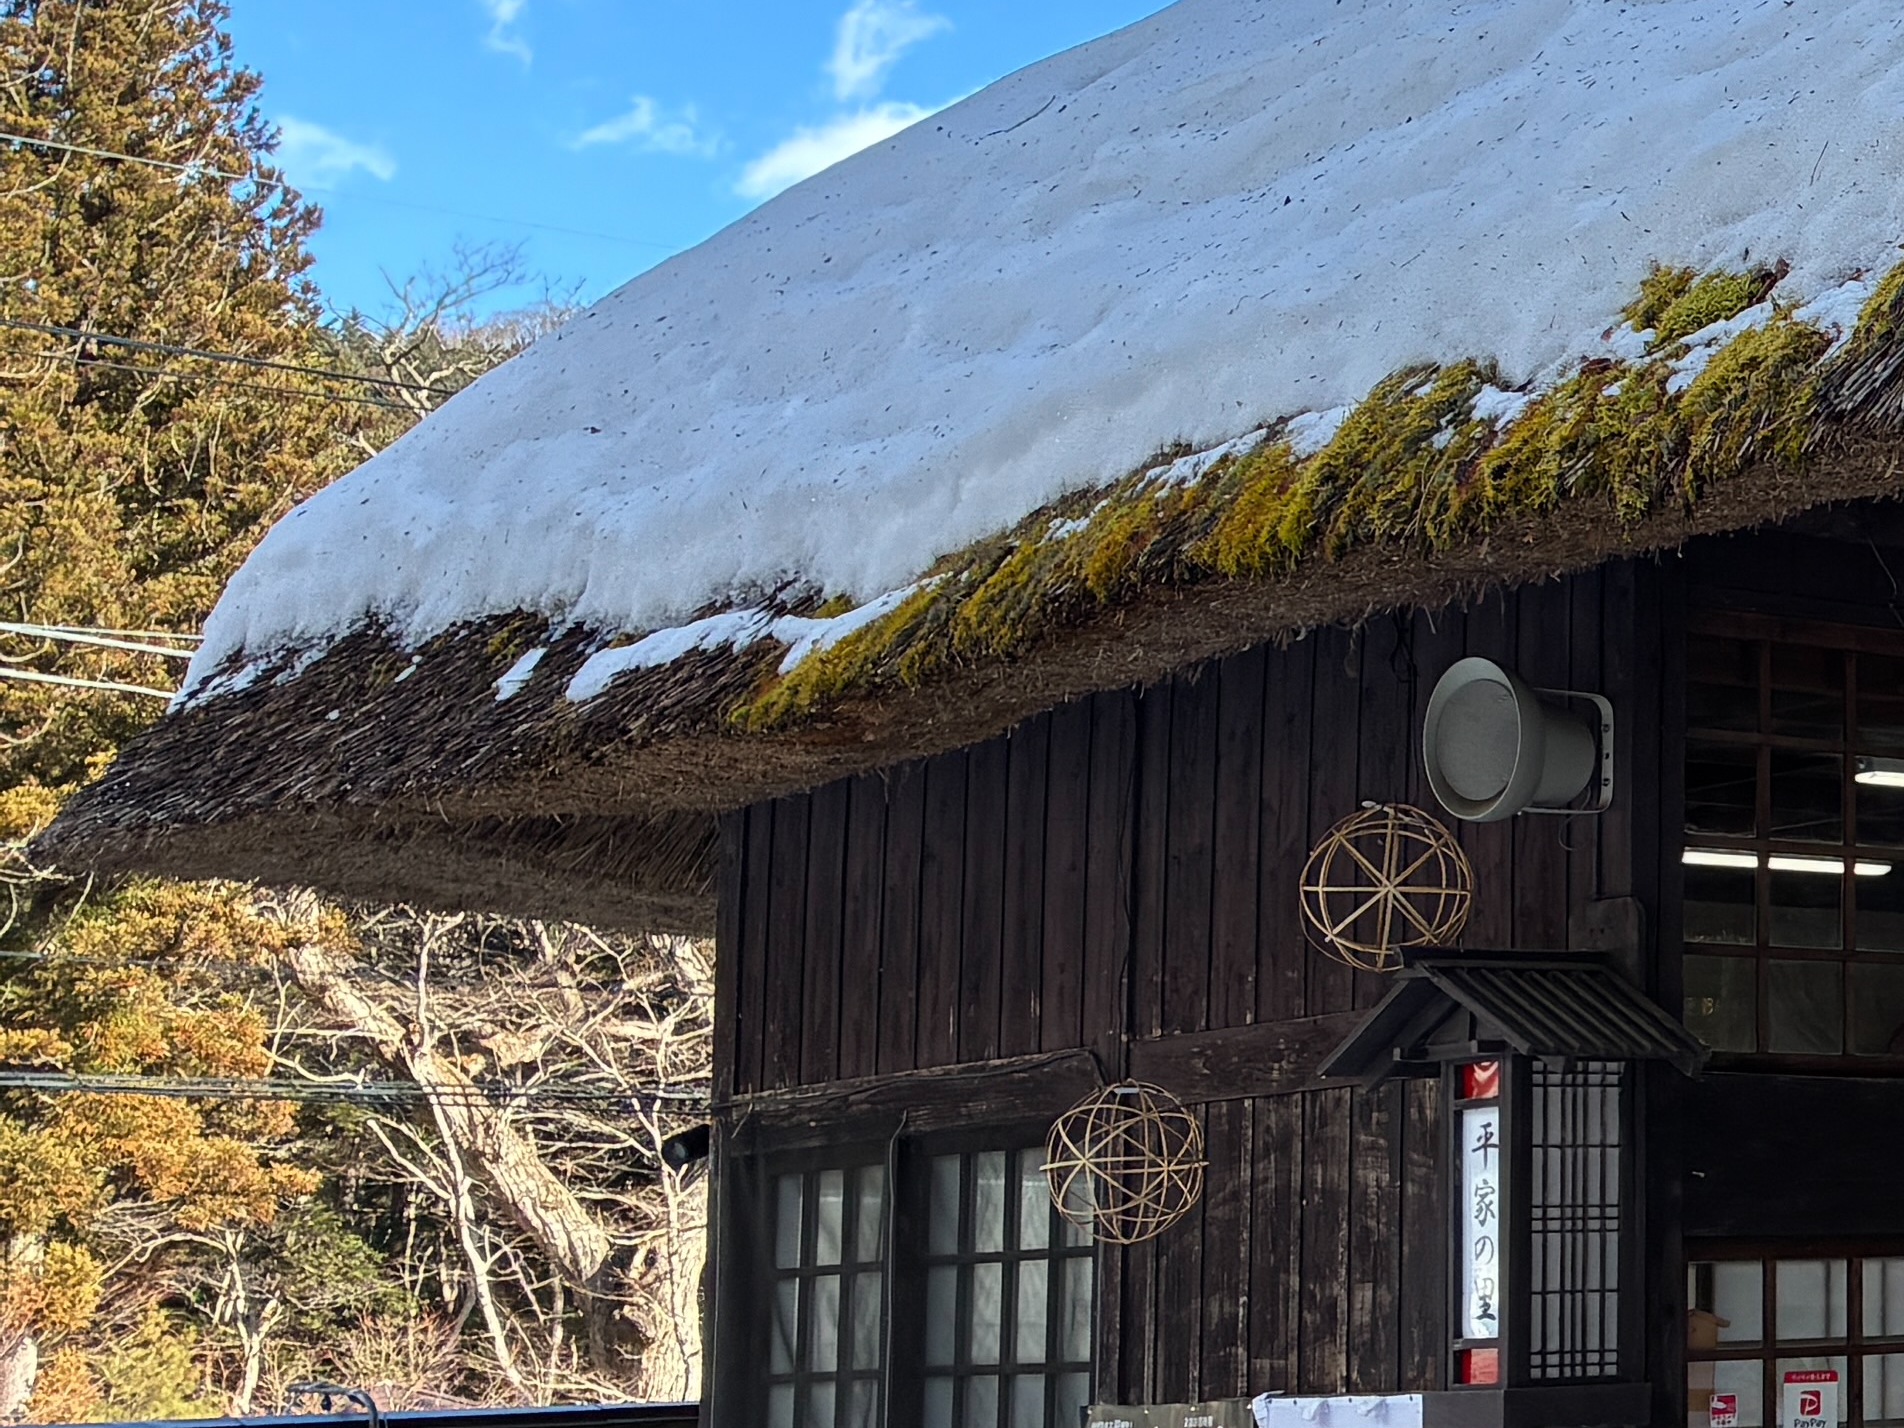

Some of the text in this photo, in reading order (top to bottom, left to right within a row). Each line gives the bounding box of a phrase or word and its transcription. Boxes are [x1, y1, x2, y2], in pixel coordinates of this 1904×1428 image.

[1471, 1119, 1499, 1324] 平家の里
[1794, 1417, 1828, 1428] PayPay
